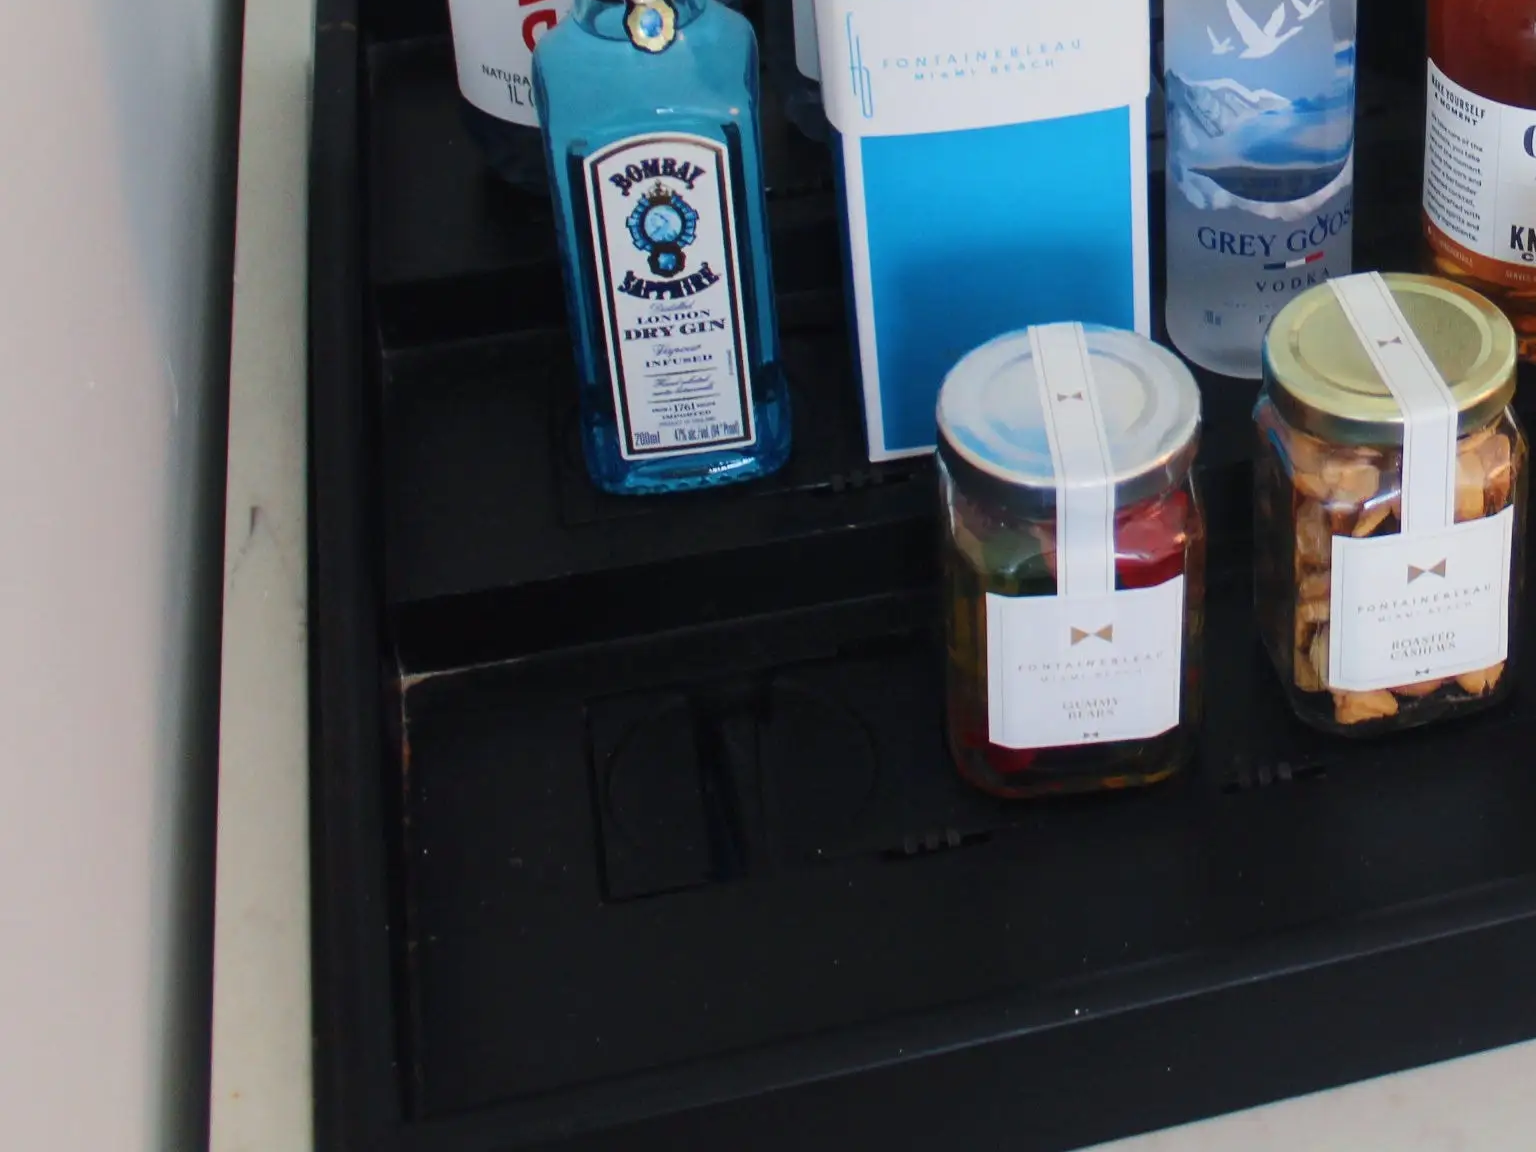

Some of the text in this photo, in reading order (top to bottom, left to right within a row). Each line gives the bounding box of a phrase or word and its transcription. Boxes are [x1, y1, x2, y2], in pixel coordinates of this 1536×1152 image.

[882, 39, 1081, 69] FONTAINEBLEAU
[482, 64, 532, 87] NATURA
[914, 59, 1055, 81] MIAMI BEACH
[1440, 97, 1478, 126] MOMENT
[1445, 88, 1486, 119] YOURSELF
[609, 158, 706, 197] BOMBAY
[1197, 203, 1353, 258] GREY GOOS
[1256, 267, 1331, 293] VODKA
[636, 308, 711, 325] LONDON
[623, 318, 727, 341] DRY GIN
[645, 354, 713, 368] INFUSED
[1357, 583, 1492, 614] FONTAINEBLEAU
[1390, 642, 1456, 661] CASHEWS
[1391, 631, 1456, 651] ROASTED
[1018, 651, 1164, 672] FONTAINEBLEAU
[1062, 697, 1119, 711] GUMMY
[1067, 708, 1115, 721] BEARS
